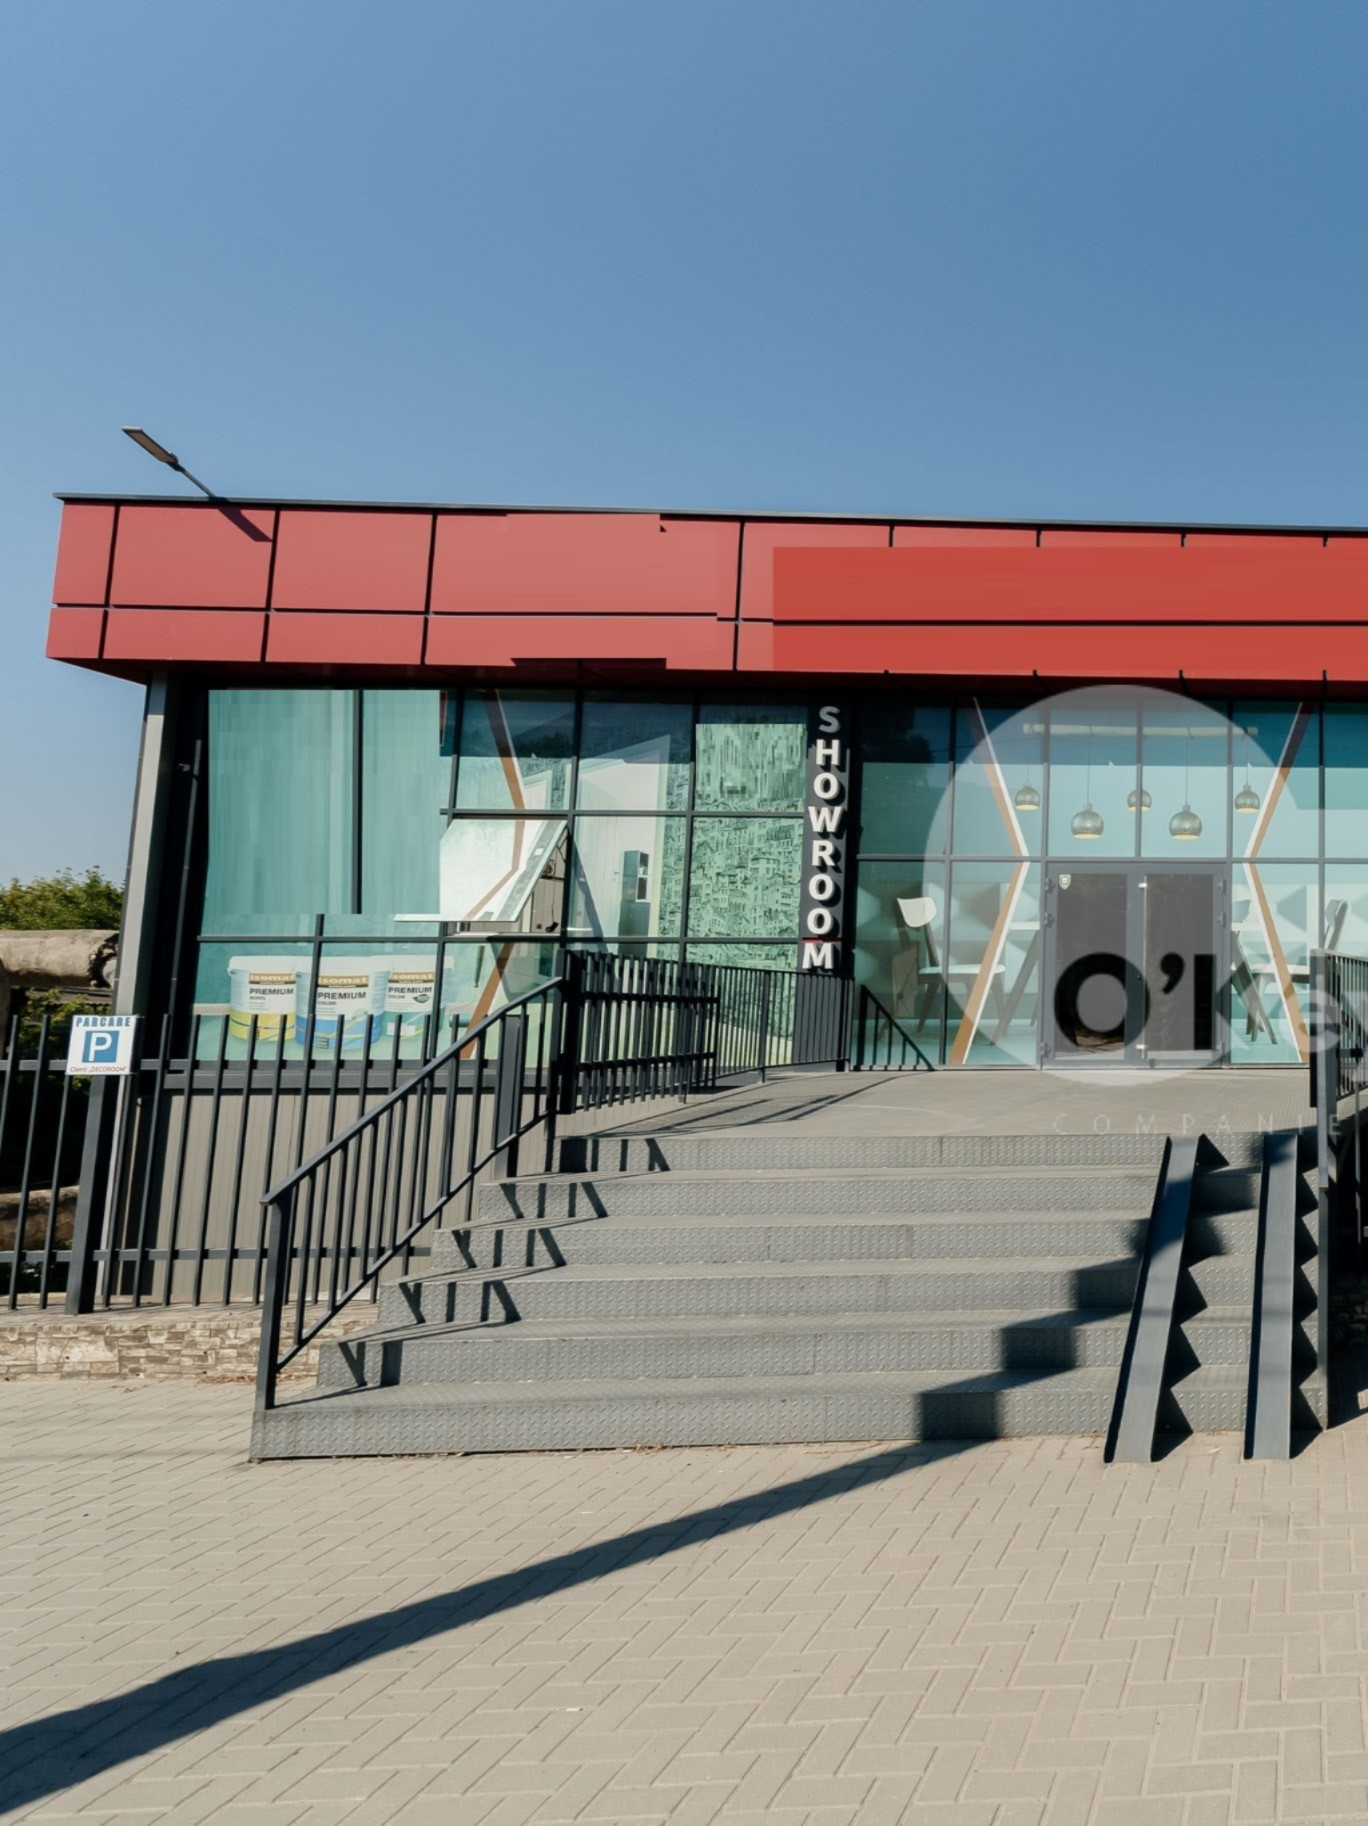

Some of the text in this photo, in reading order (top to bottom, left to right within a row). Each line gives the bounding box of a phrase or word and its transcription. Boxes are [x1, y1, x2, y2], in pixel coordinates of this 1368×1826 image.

[802, 705, 844, 970] SHOWROOM
[249, 987, 294, 995] PREMIUM
[317, 991, 367, 999] PREMIUM
[76, 1016, 131, 1027] PARCARE
[88, 1032, 113, 1062] P
